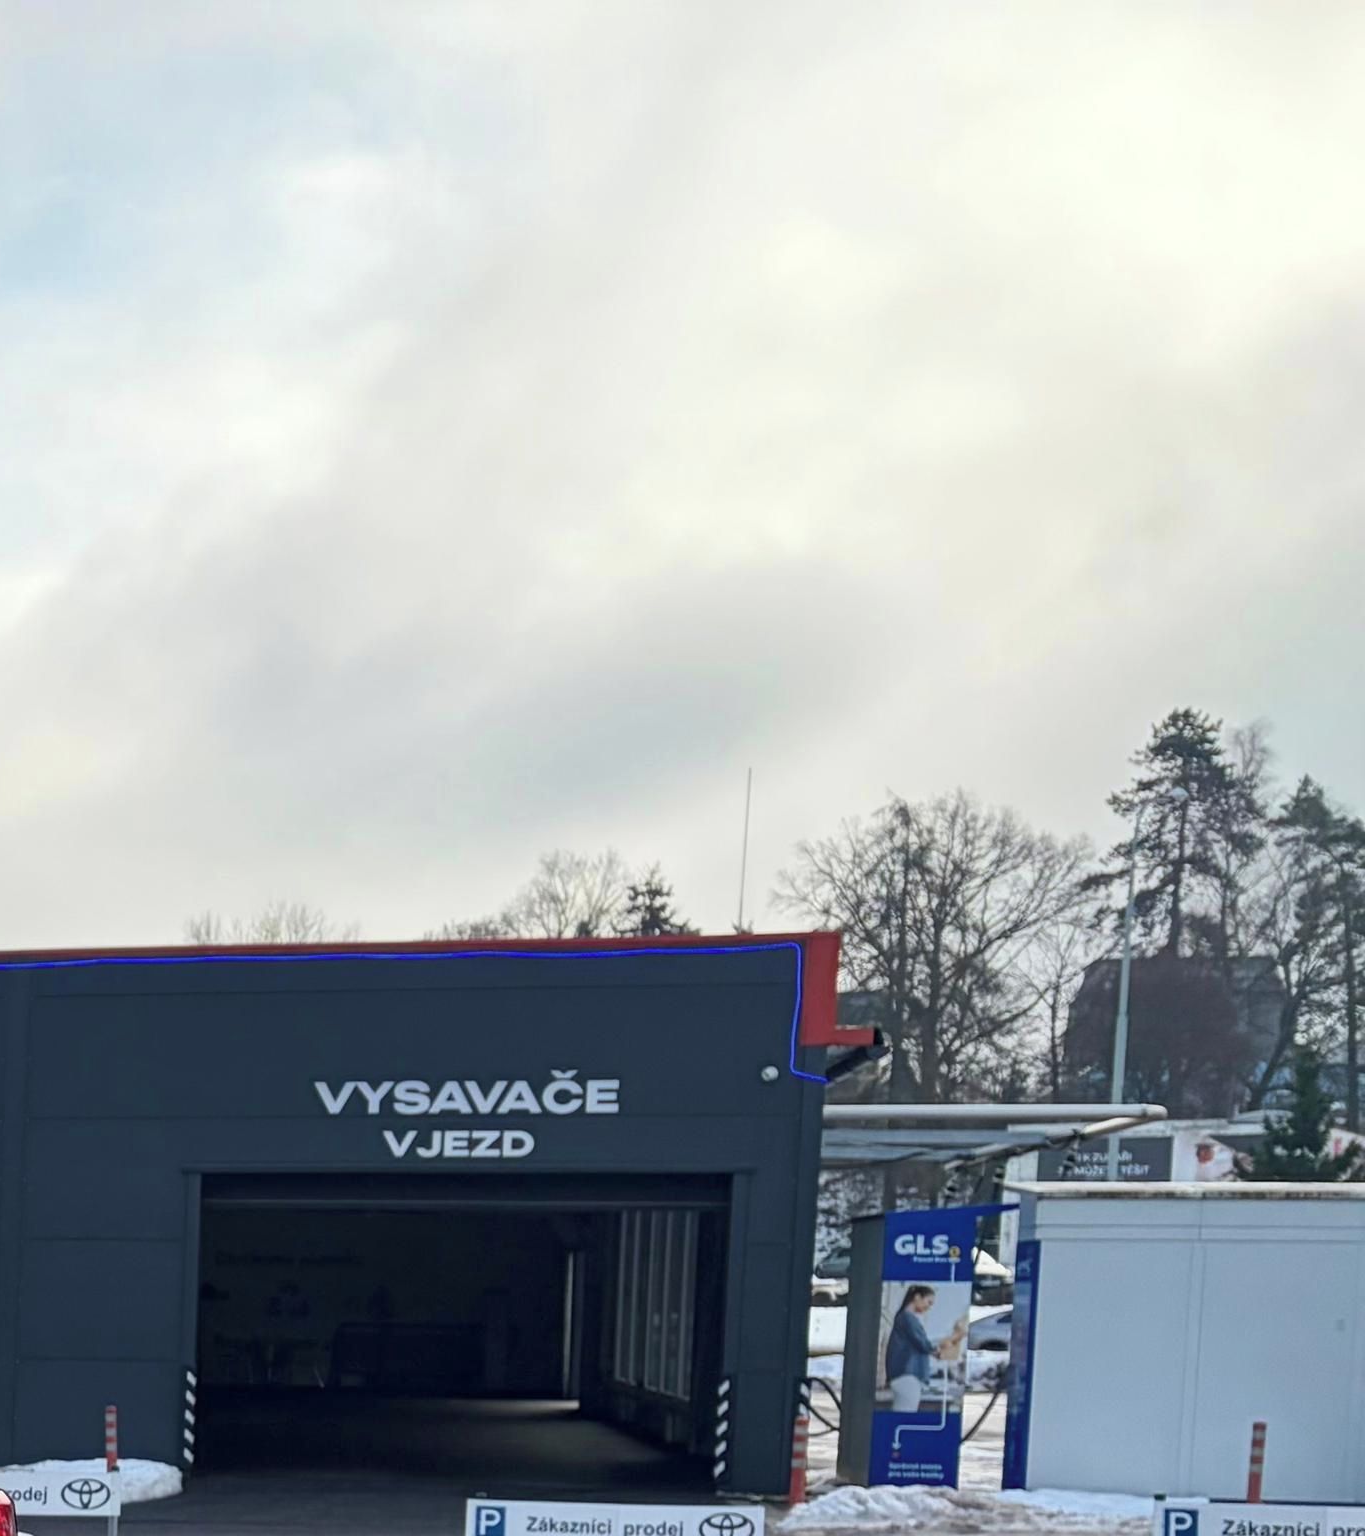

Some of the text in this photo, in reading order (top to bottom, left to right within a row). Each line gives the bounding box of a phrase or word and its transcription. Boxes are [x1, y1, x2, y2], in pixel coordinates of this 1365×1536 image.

[314, 1069, 620, 1115] VYSAVAČE
[382, 1129, 536, 1158] VJEZD
[479, 1509, 501, 1536] P
[526, 1515, 612, 1536] Zákazníci
